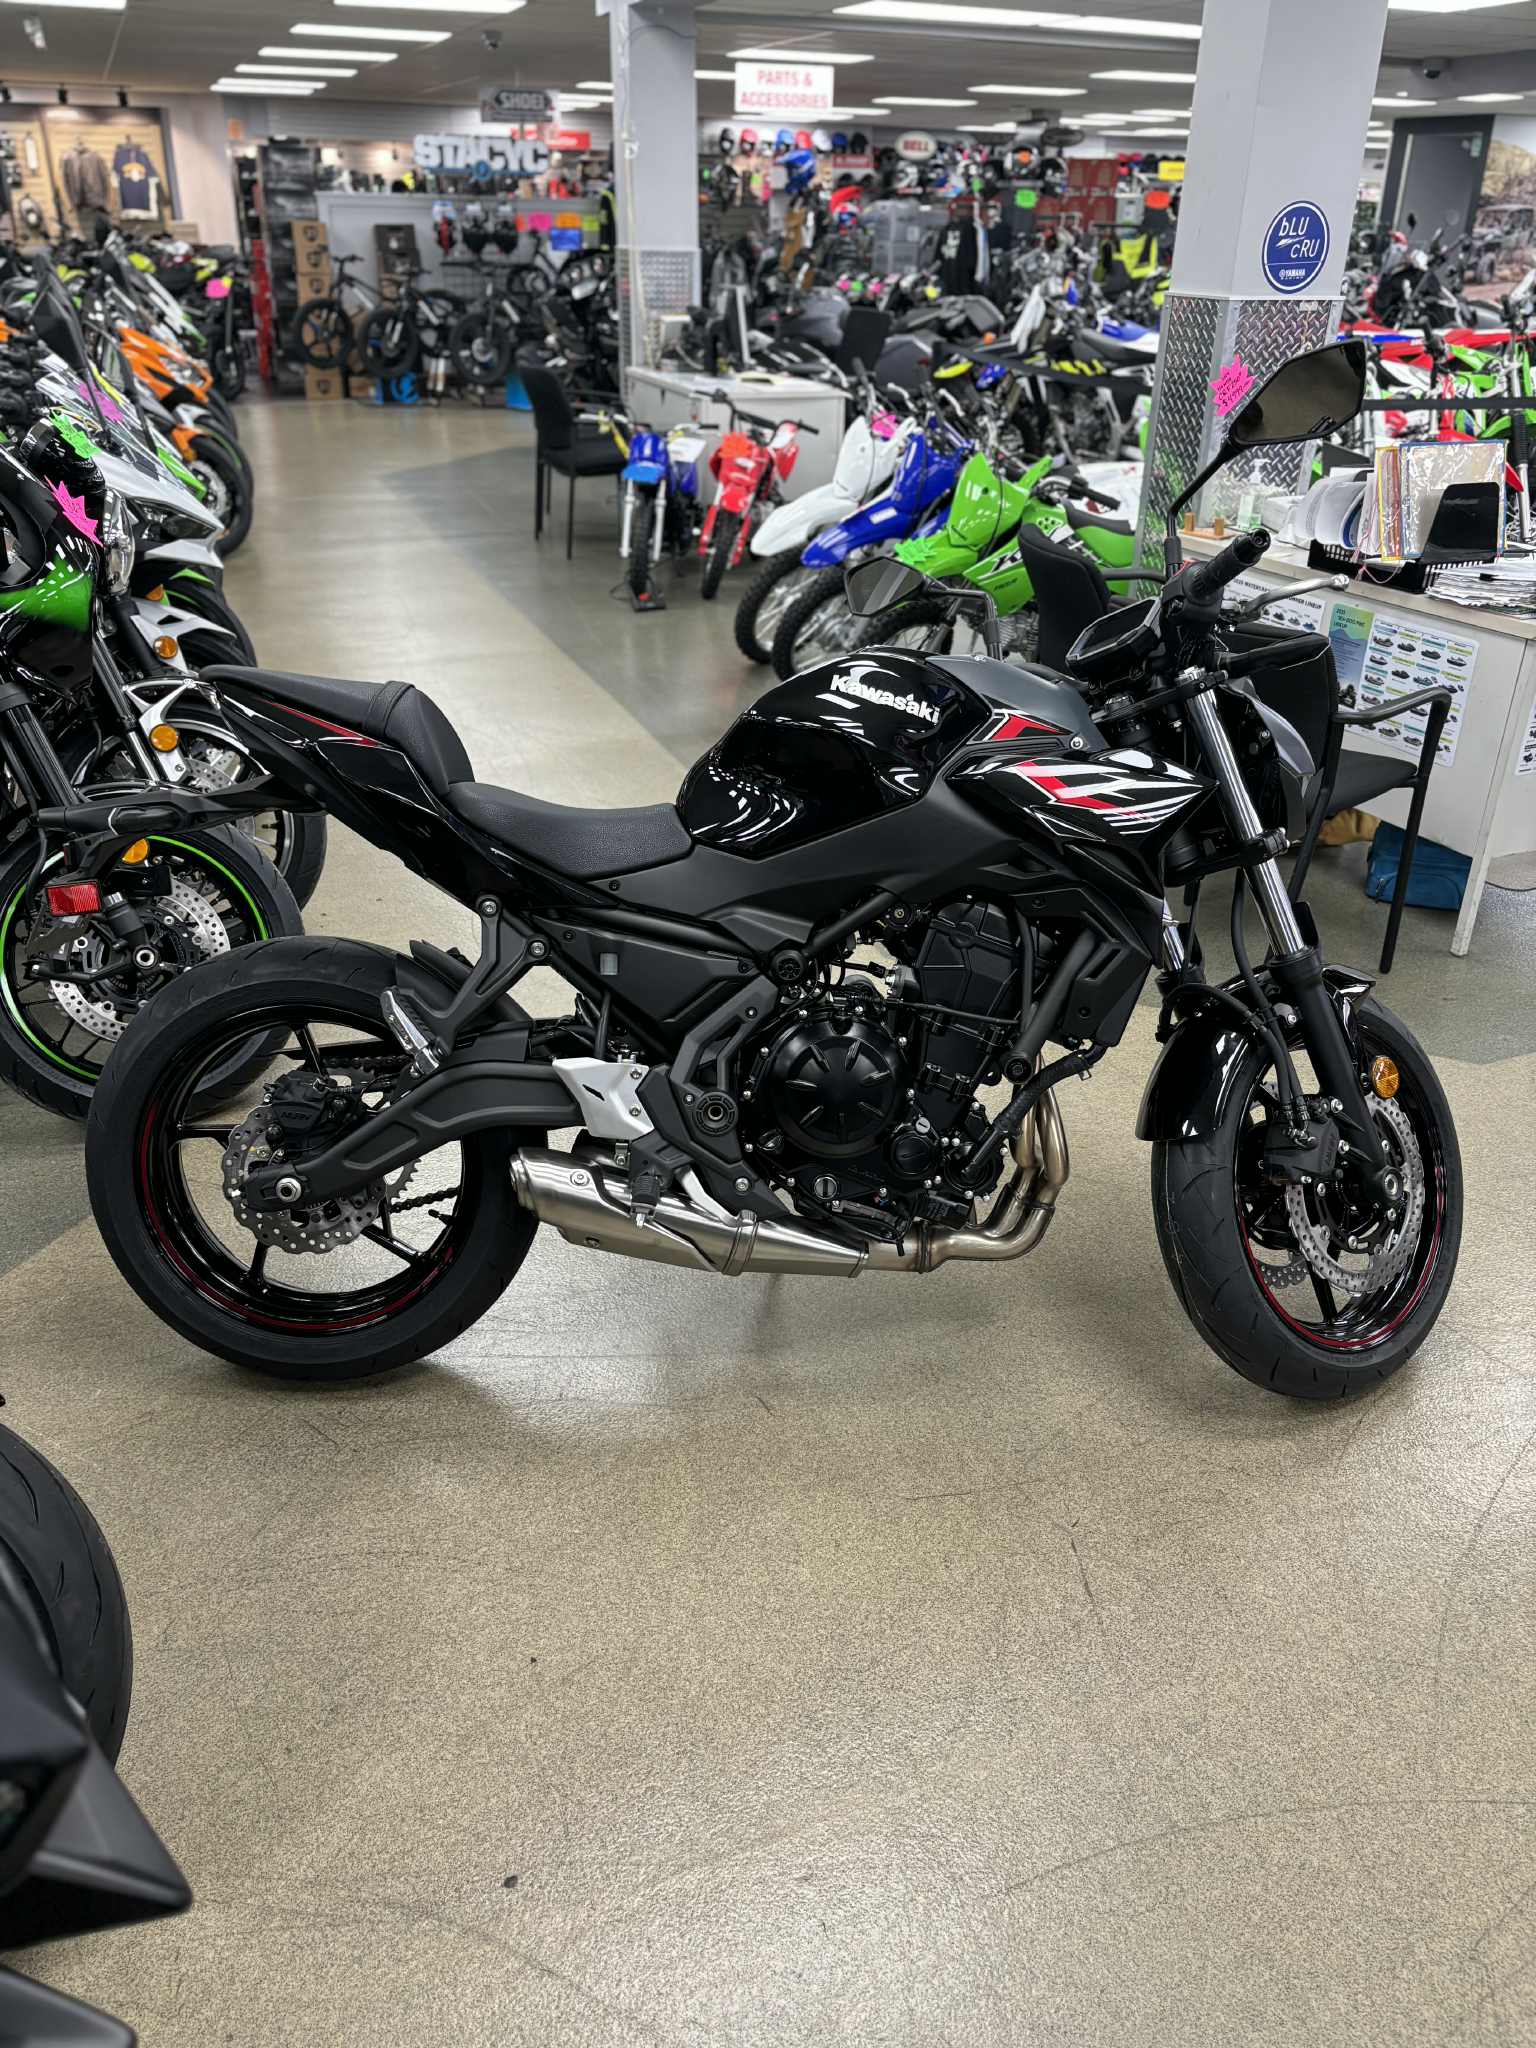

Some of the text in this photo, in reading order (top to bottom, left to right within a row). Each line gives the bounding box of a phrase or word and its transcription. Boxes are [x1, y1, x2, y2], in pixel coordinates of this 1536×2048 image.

[757, 70, 813, 86] PARTS &
[500, 91, 545, 110] SHOEI
[740, 91, 829, 108] ACCESSORIES
[413, 134, 549, 173] STACYC
[903, 139, 929, 151] BELL
[1286, 268, 1306, 277] YAMAHA
[830, 674, 940, 723] Kawasaki
